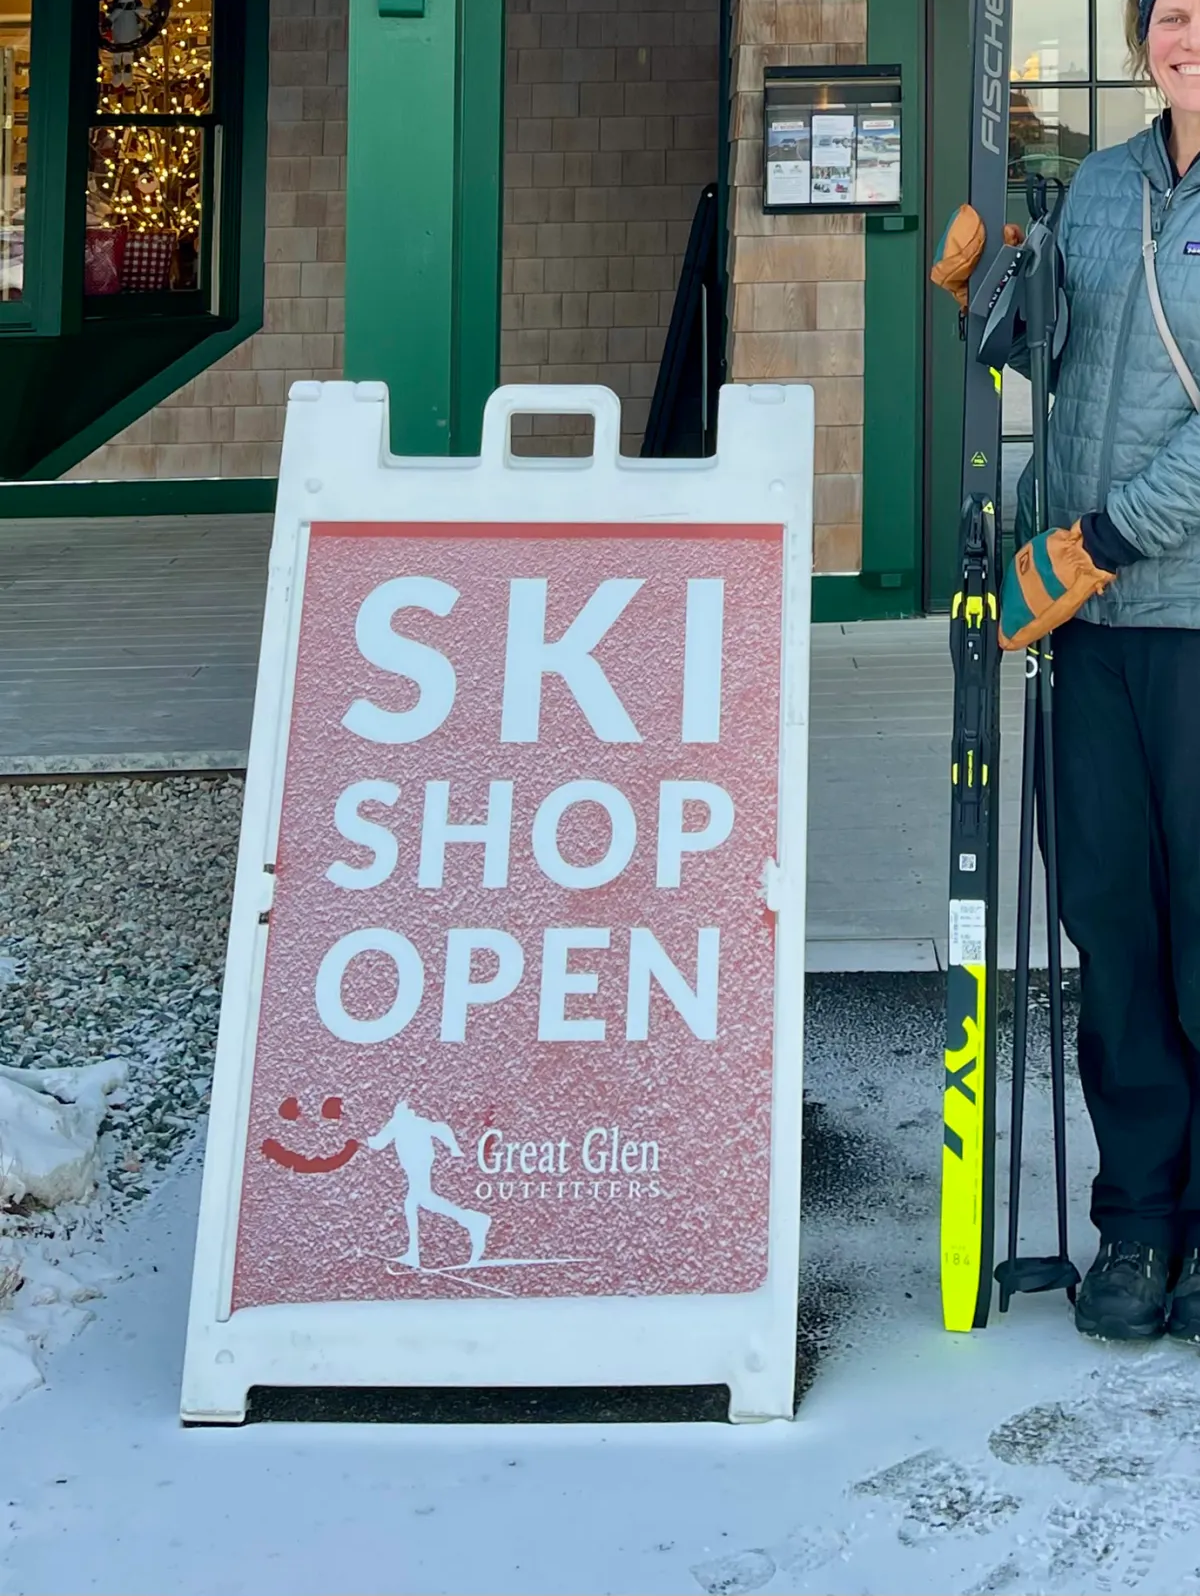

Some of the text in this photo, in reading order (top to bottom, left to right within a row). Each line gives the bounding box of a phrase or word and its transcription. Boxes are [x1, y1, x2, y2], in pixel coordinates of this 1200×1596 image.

[340, 575, 727, 745] SKI
[325, 778, 737, 891] SHOP
[314, 926, 722, 1044] OPEN
[475, 1180, 661, 1200] OUTFITTERS
[477, 1125, 660, 1174] Great Glen
